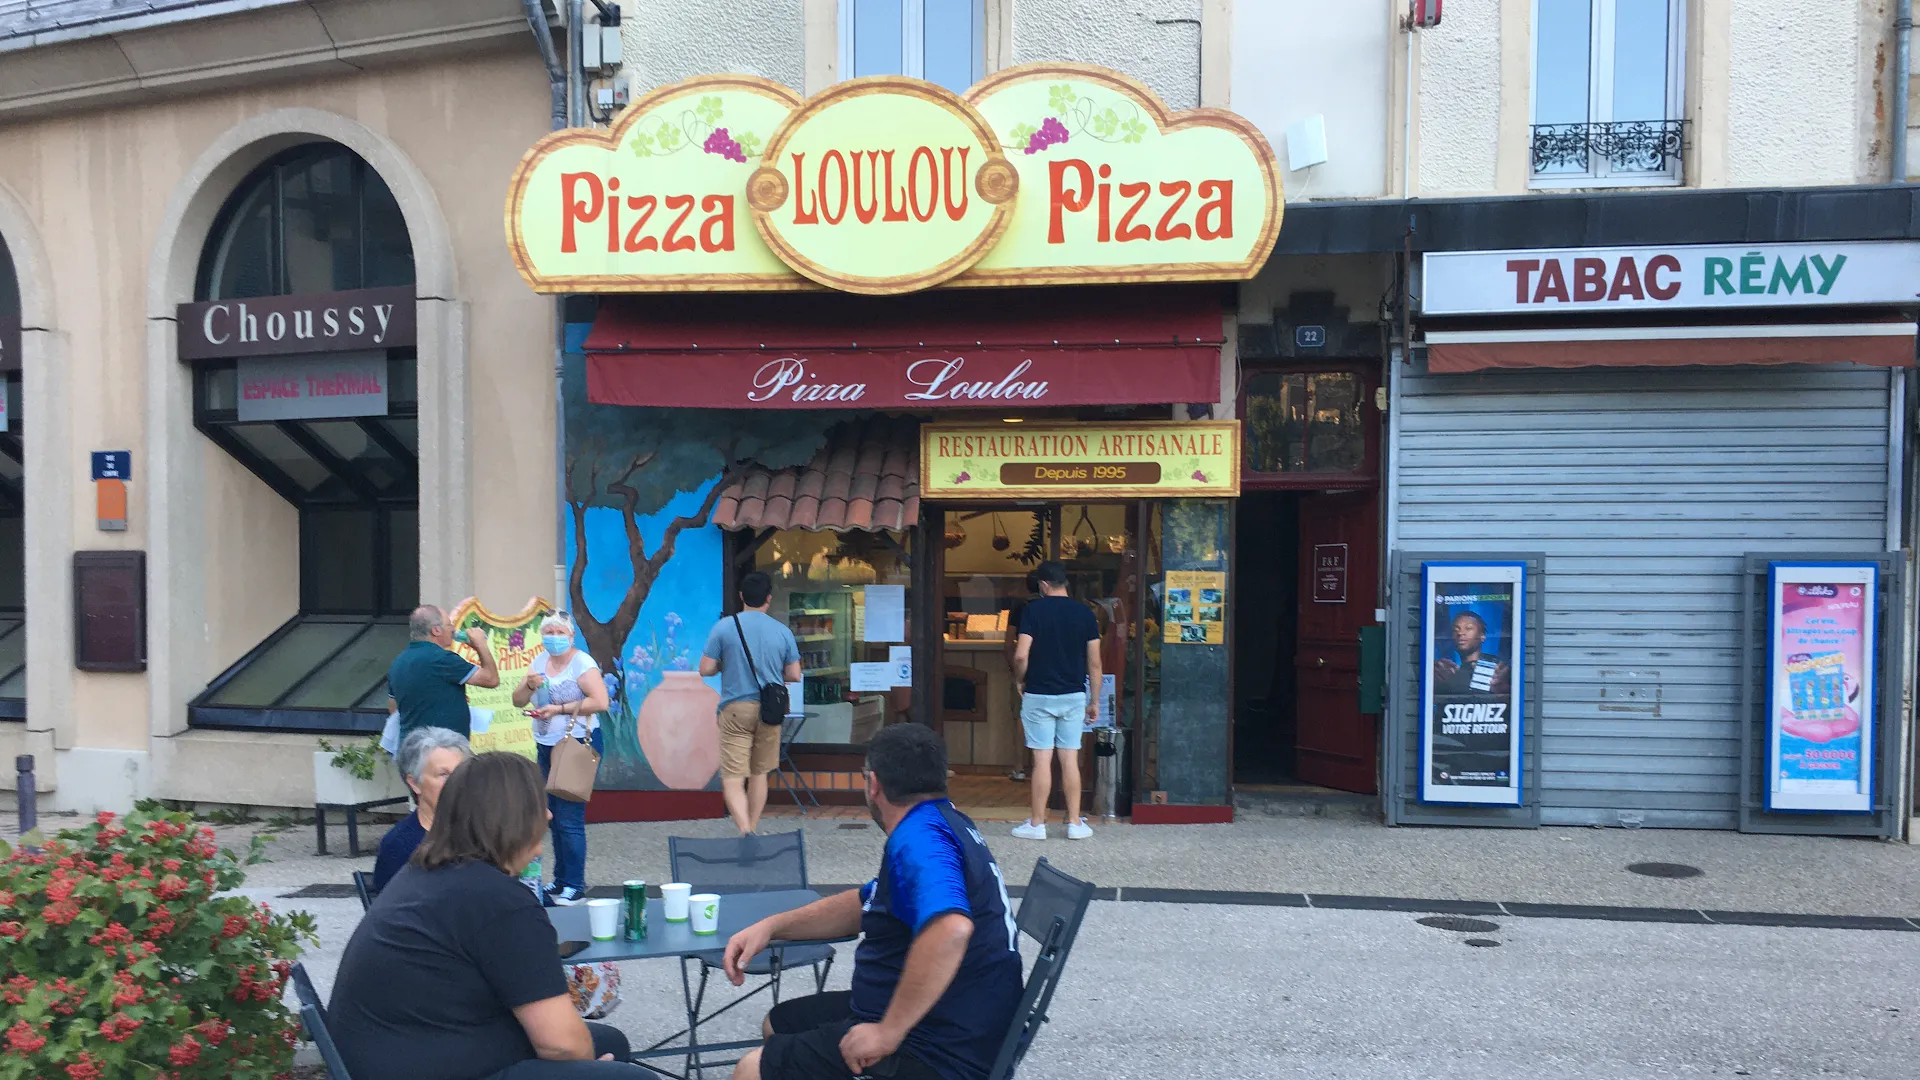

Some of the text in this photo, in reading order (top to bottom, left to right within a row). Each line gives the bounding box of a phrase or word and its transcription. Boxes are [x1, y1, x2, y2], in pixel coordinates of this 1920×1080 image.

[791, 146, 970, 225] LOULOU
[1047, 158, 1234, 244] Pizza
[561, 171, 735, 253] Pizza
[1506, 251, 1848, 304] TABAC RÉMY
[203, 303, 394, 345] Choussy
[1304, 331, 1317, 342] 22
[747, 356, 1048, 402] Pizza Loulou
[938, 433, 1223, 458] RESTAURATION ARTISANALE
[1035, 466, 1126, 481] Depuis 1995
[1442, 703, 1507, 723] SIGNEZ
[1442, 723, 1508, 734] VOTRE RETOUR
